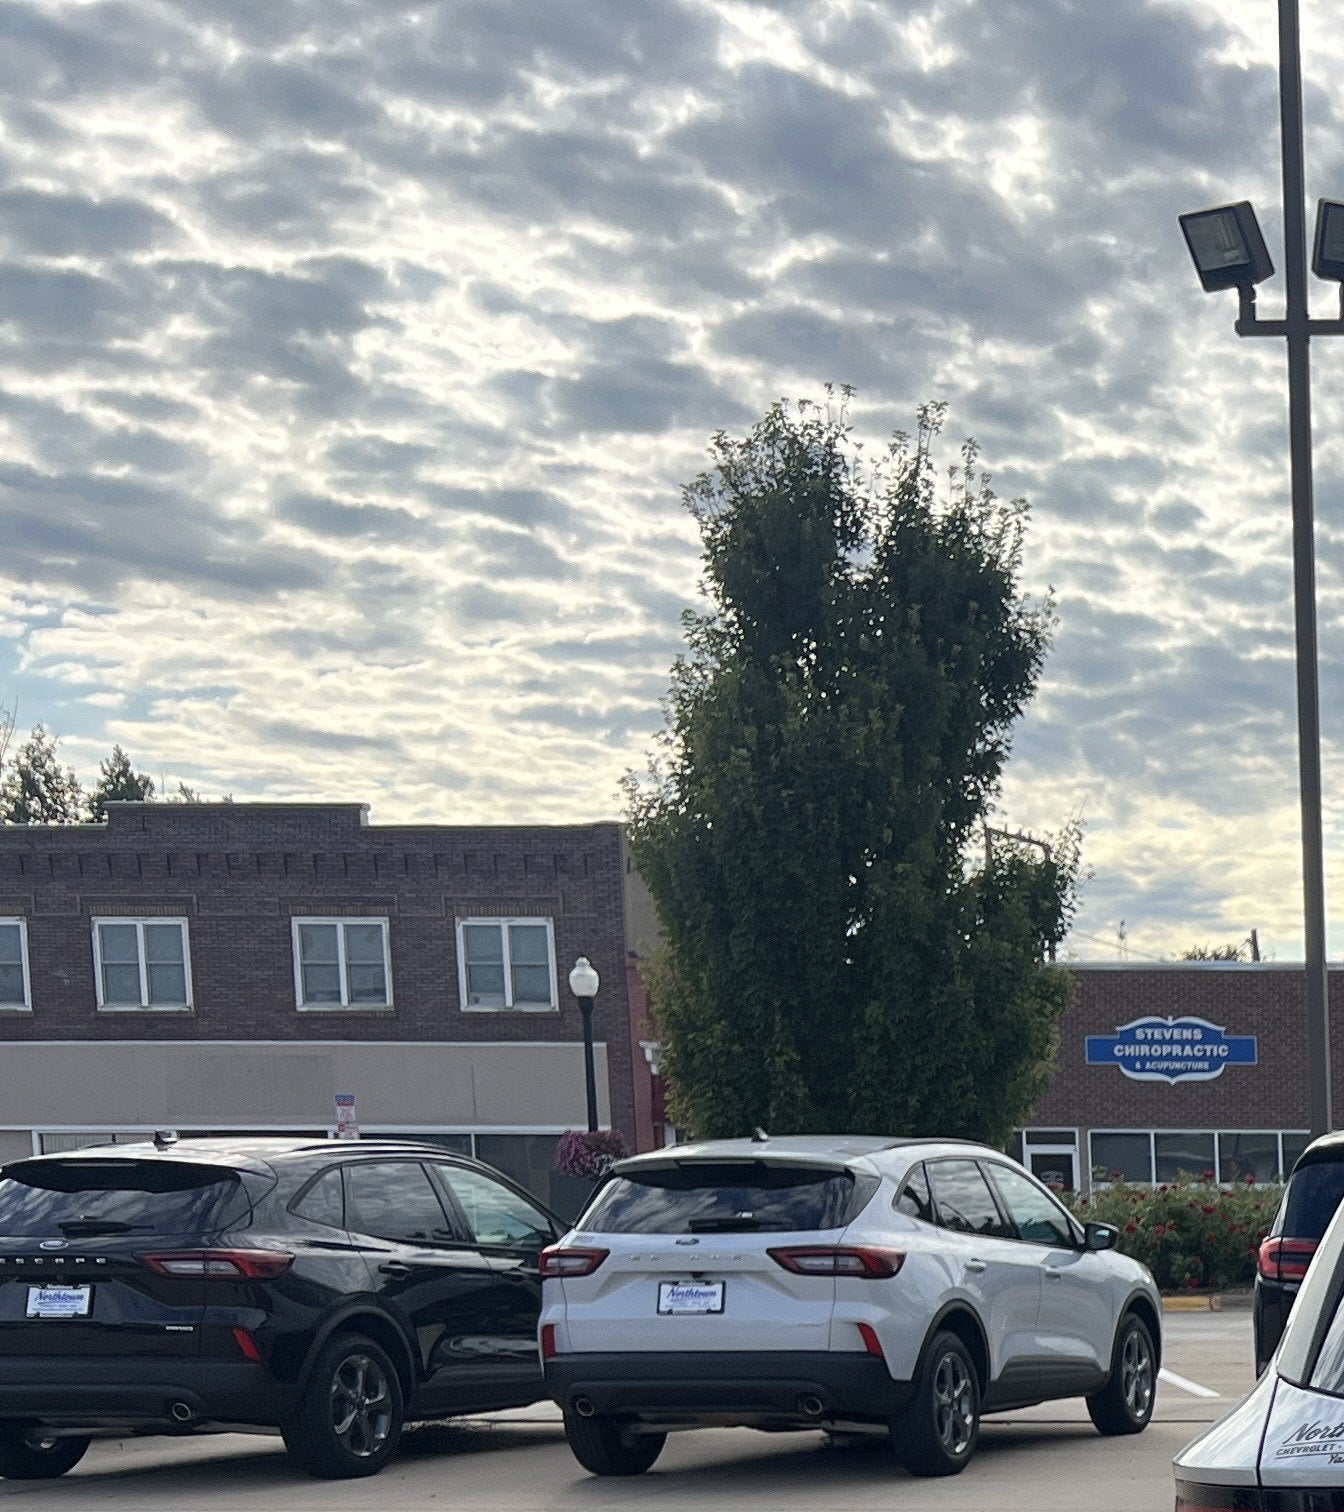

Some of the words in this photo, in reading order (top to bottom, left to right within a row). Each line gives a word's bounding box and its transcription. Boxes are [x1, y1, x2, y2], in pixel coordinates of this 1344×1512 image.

[1135, 1028, 1203, 1040] STEVENS
[1113, 1045, 1229, 1057] CHIROPRACTIC
[1145, 1062, 1209, 1070] ACUPUNCTURE
[1276, 1444, 1336, 1455] CHEVROLET
